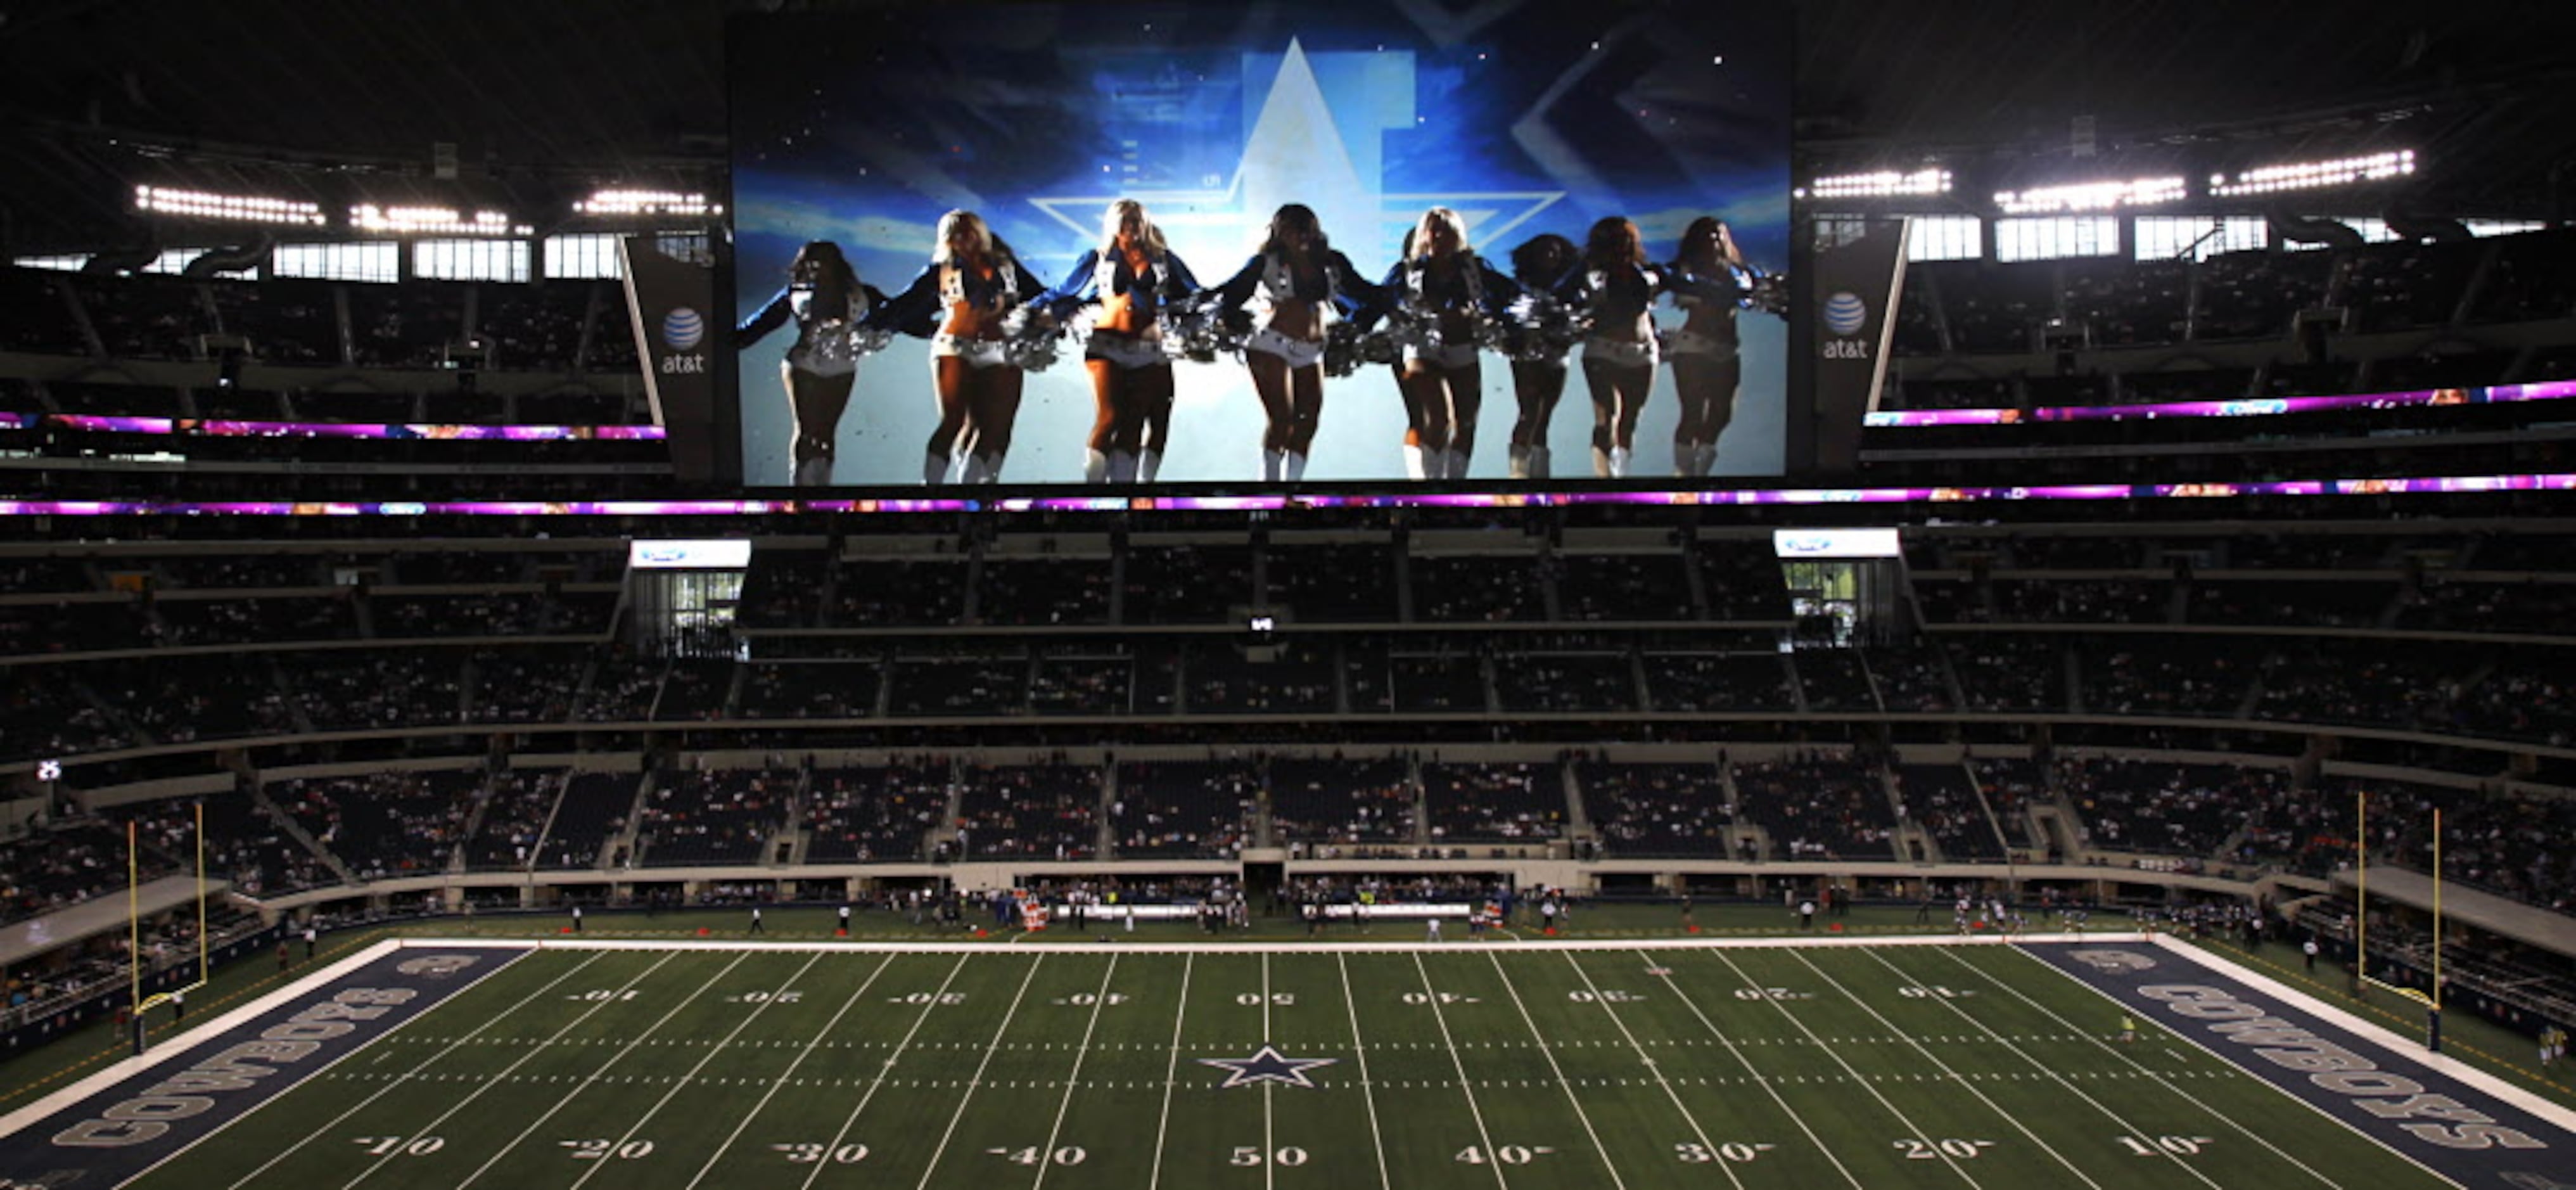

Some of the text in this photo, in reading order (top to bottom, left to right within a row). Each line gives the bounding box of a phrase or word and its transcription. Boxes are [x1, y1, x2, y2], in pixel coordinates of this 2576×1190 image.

[662, 353, 705, 373] at&t
[1823, 338, 1868, 359] at&t
[51, 987, 418, 1147] COWBOYS
[2137, 985, 2549, 1149] COWBOYS
